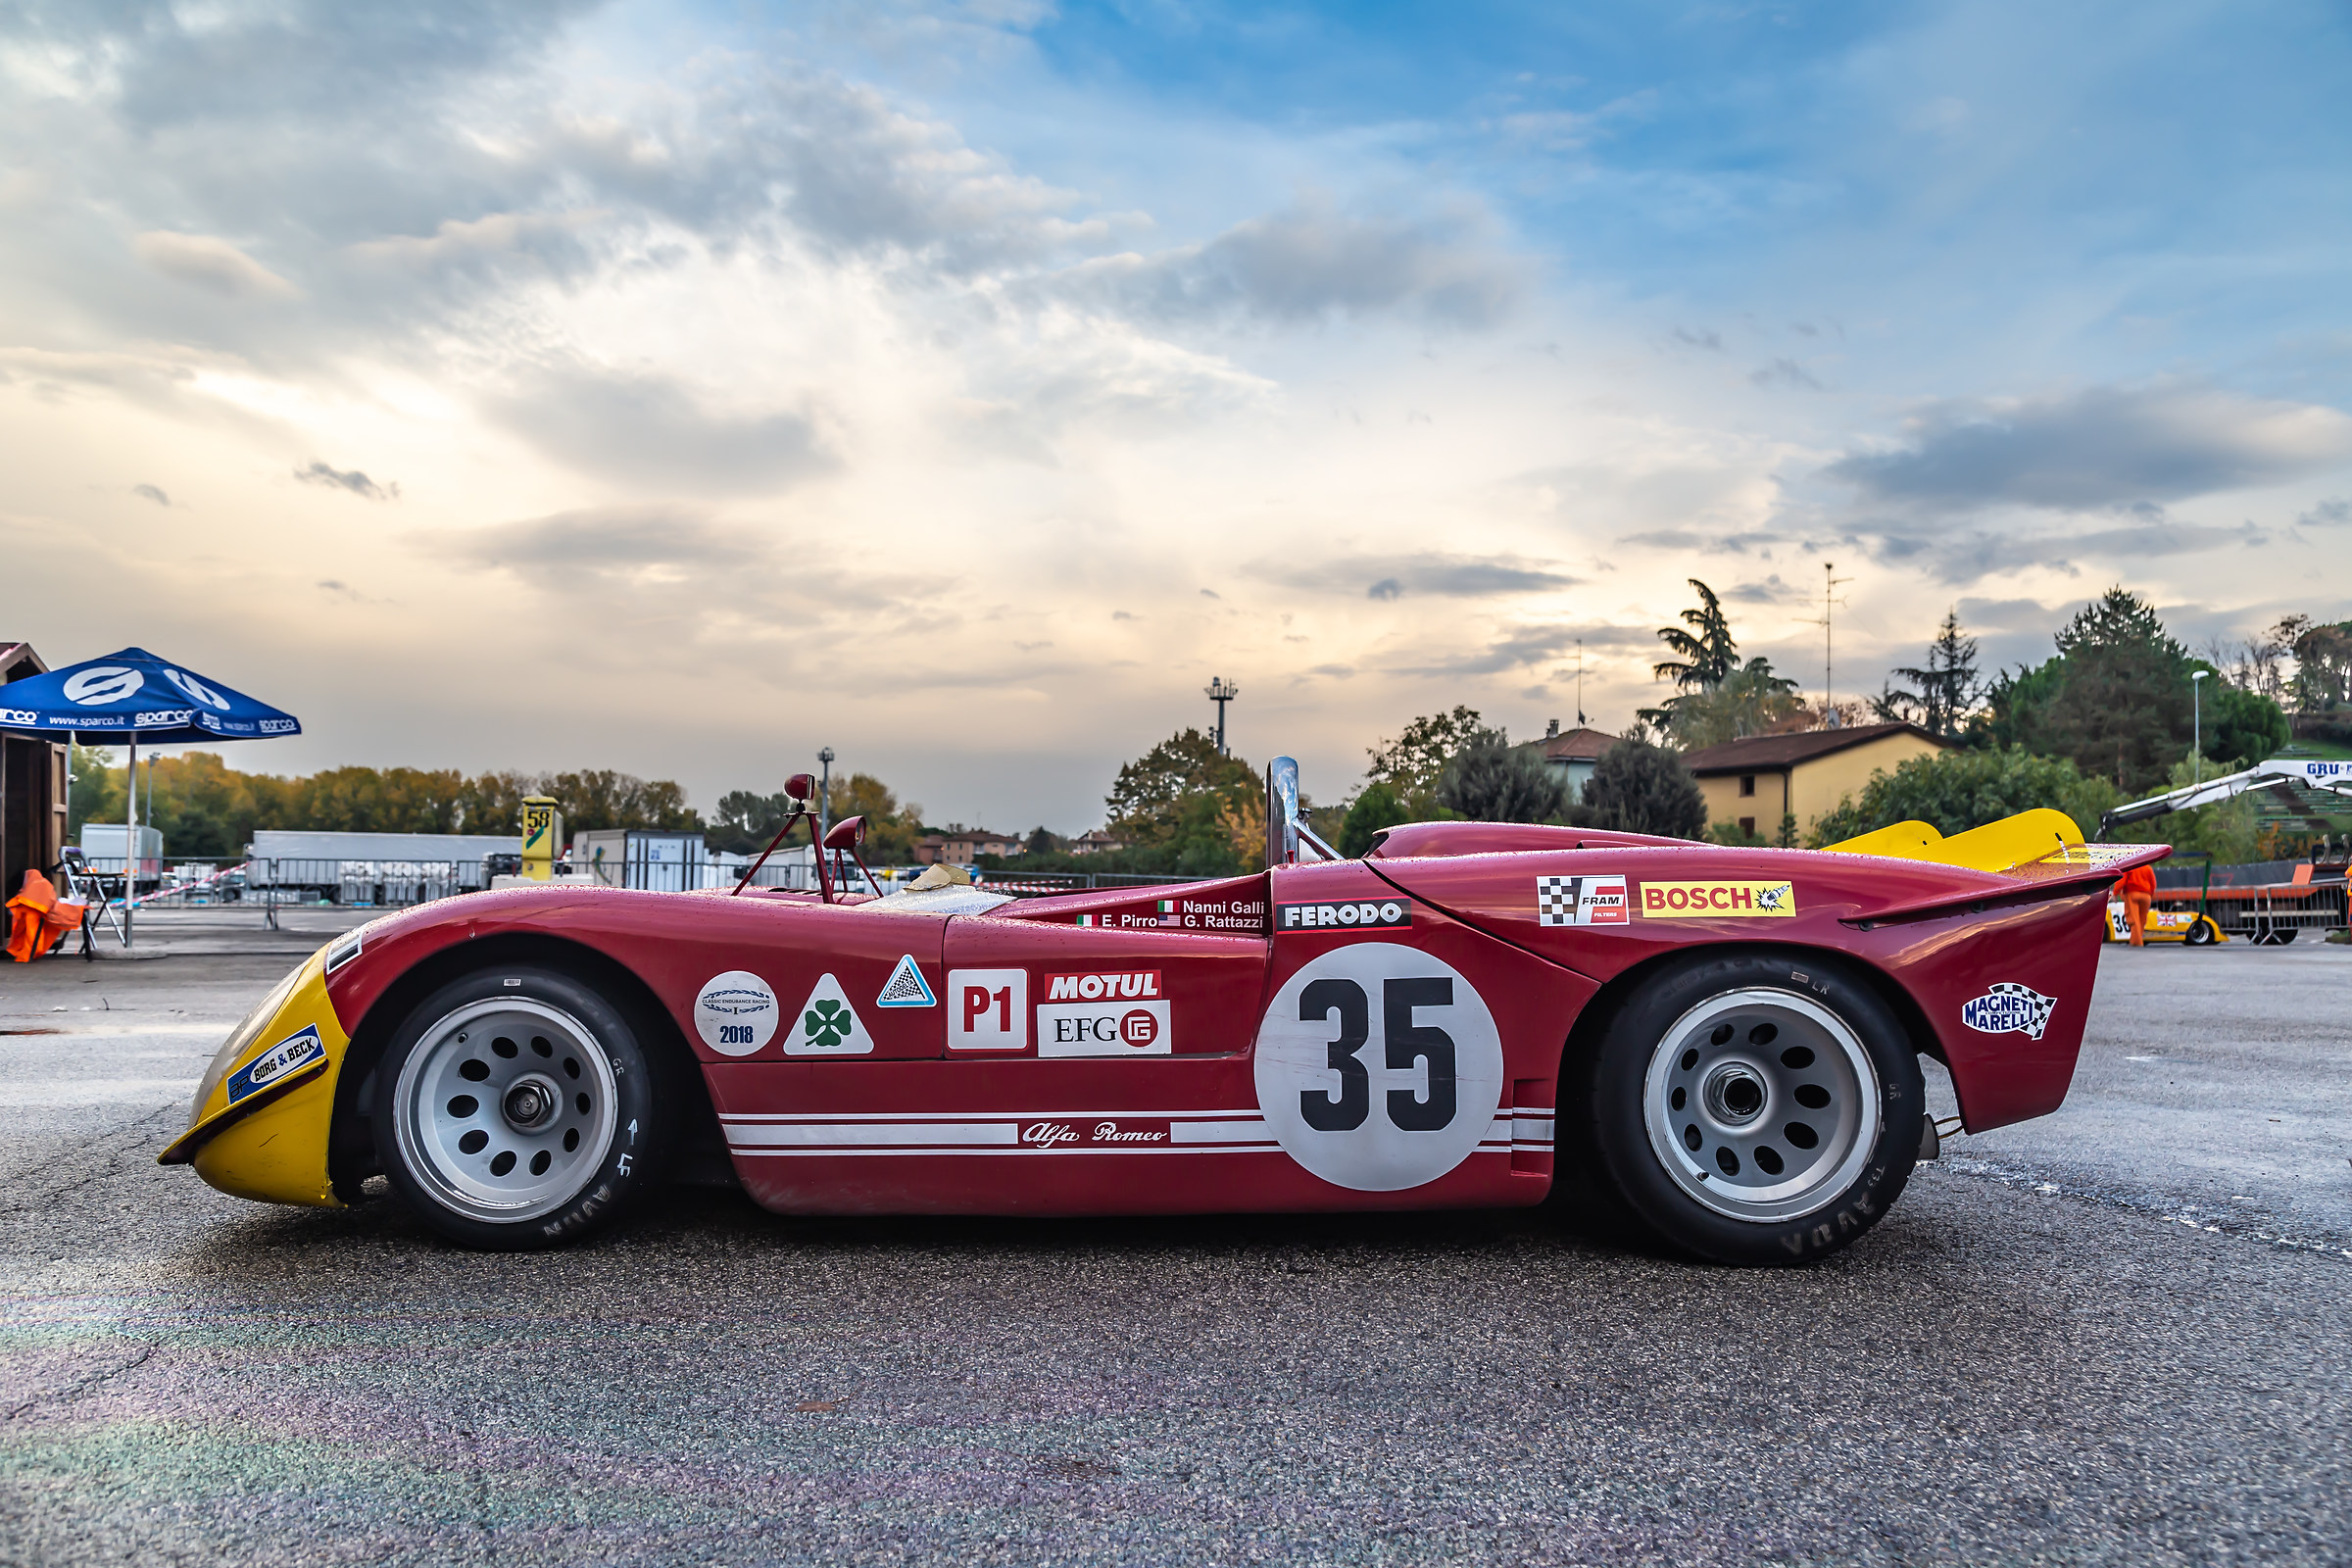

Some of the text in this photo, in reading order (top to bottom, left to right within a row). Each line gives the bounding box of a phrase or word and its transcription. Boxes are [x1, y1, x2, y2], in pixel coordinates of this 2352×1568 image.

[49, 716, 125, 727] www.sparco.it
[2307, 763, 2339, 774] GRU
[527, 810, 550, 828] 58
[1183, 901, 1264, 913] Nanni Galli
[1583, 897, 1619, 906] FRAM
[1644, 887, 1752, 910] BOSCH
[1102, 914, 1157, 927] E. Pirro
[1184, 915, 1263, 928] G. Rattazzi
[1285, 903, 1402, 927] FERODO
[1049, 973, 1158, 1000] MOTUL
[963, 986, 1011, 1032] P1
[1965, 995, 2033, 1020] MAGNETI
[1965, 1007, 2033, 1031] MARELLI
[719, 1026, 754, 1044] 2018
[1054, 1016, 1117, 1043] EFG
[254, 1037, 316, 1082] BORG & BECK
[1298, 977, 1457, 1131] 35
[1022, 1121, 1167, 1149] Alfa Romeo
